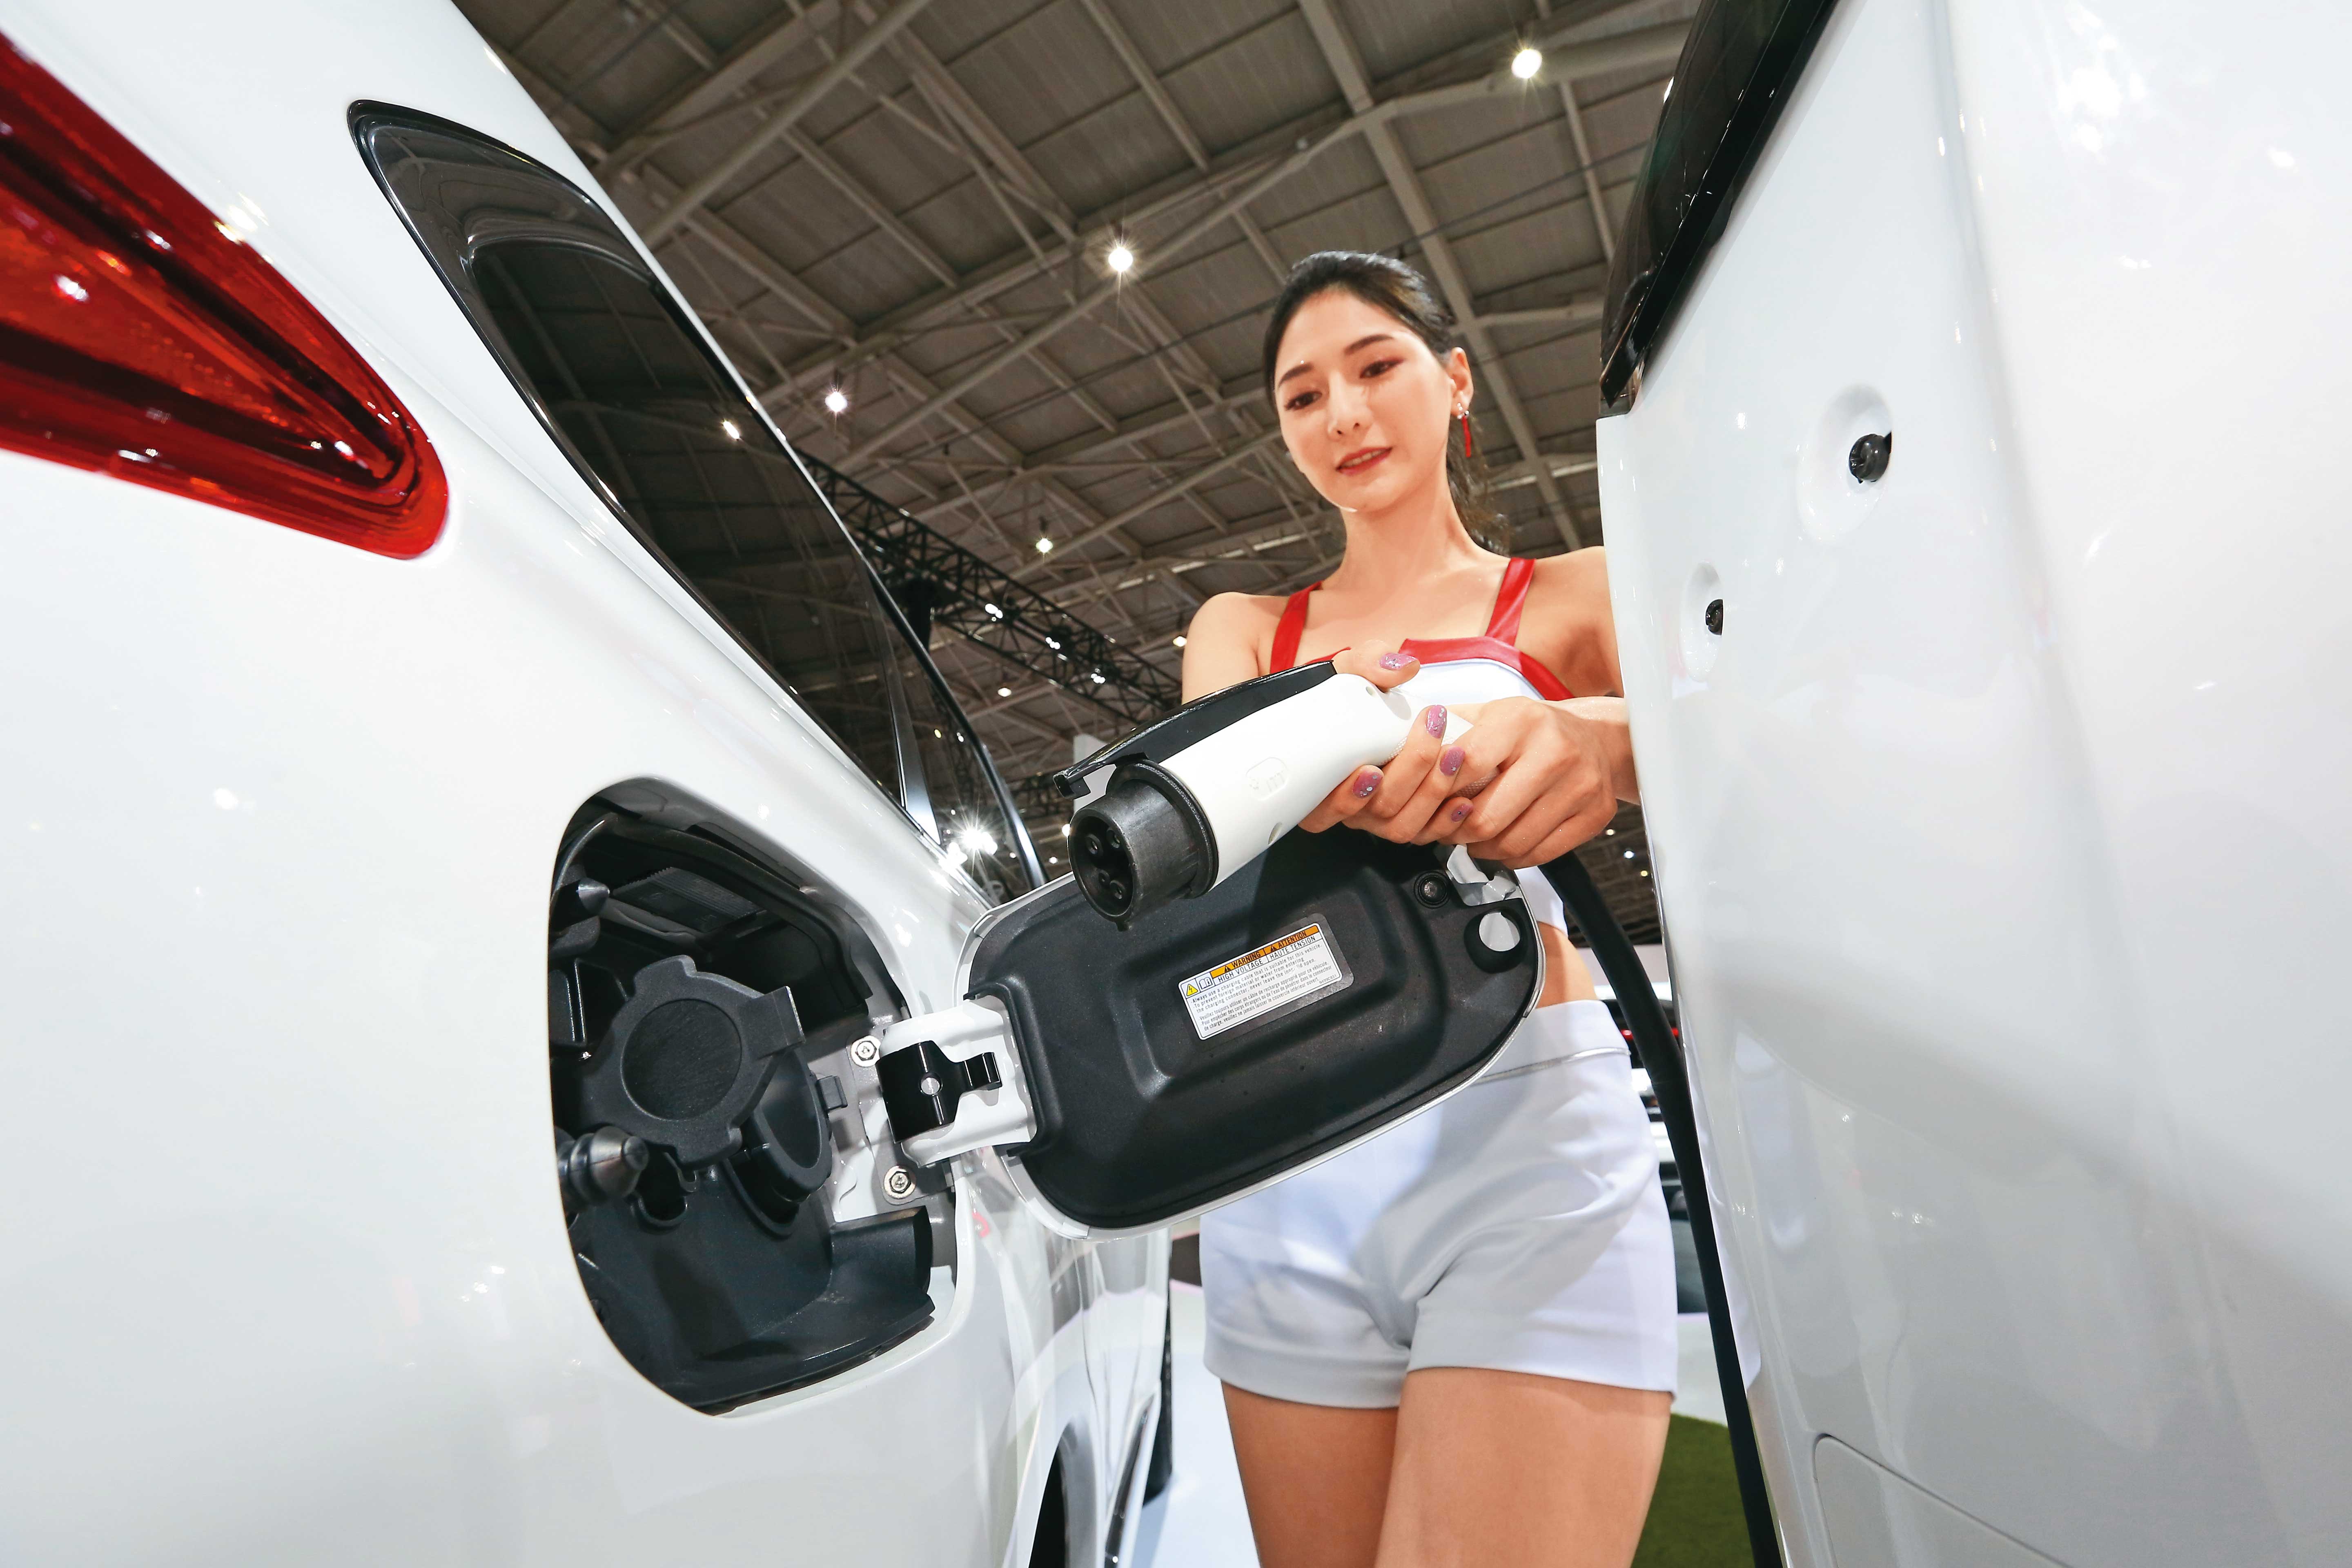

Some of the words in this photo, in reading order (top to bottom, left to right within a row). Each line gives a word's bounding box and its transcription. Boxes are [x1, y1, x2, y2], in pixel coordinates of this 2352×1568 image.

[1269, 947, 1290, 960] HAUTE
[1290, 935, 1316, 951] TENSION
[1278, 931, 1307, 948] ATTENTION
[1218, 971, 1234, 983] HIGH
[1235, 958, 1263, 975] VOLTAGE
[1232, 951, 1261, 968] WARNING
[1200, 995, 1218, 1006] prevent
[1218, 988, 1234, 998] foreign
[1235, 978, 1254, 990] material
[1261, 971, 1273, 979] water
[1285, 957, 1305, 968] entering
[1221, 980, 1241, 991] charging
[1269, 959, 1287, 969] suitable
[1205, 999, 1225, 1010] charging
